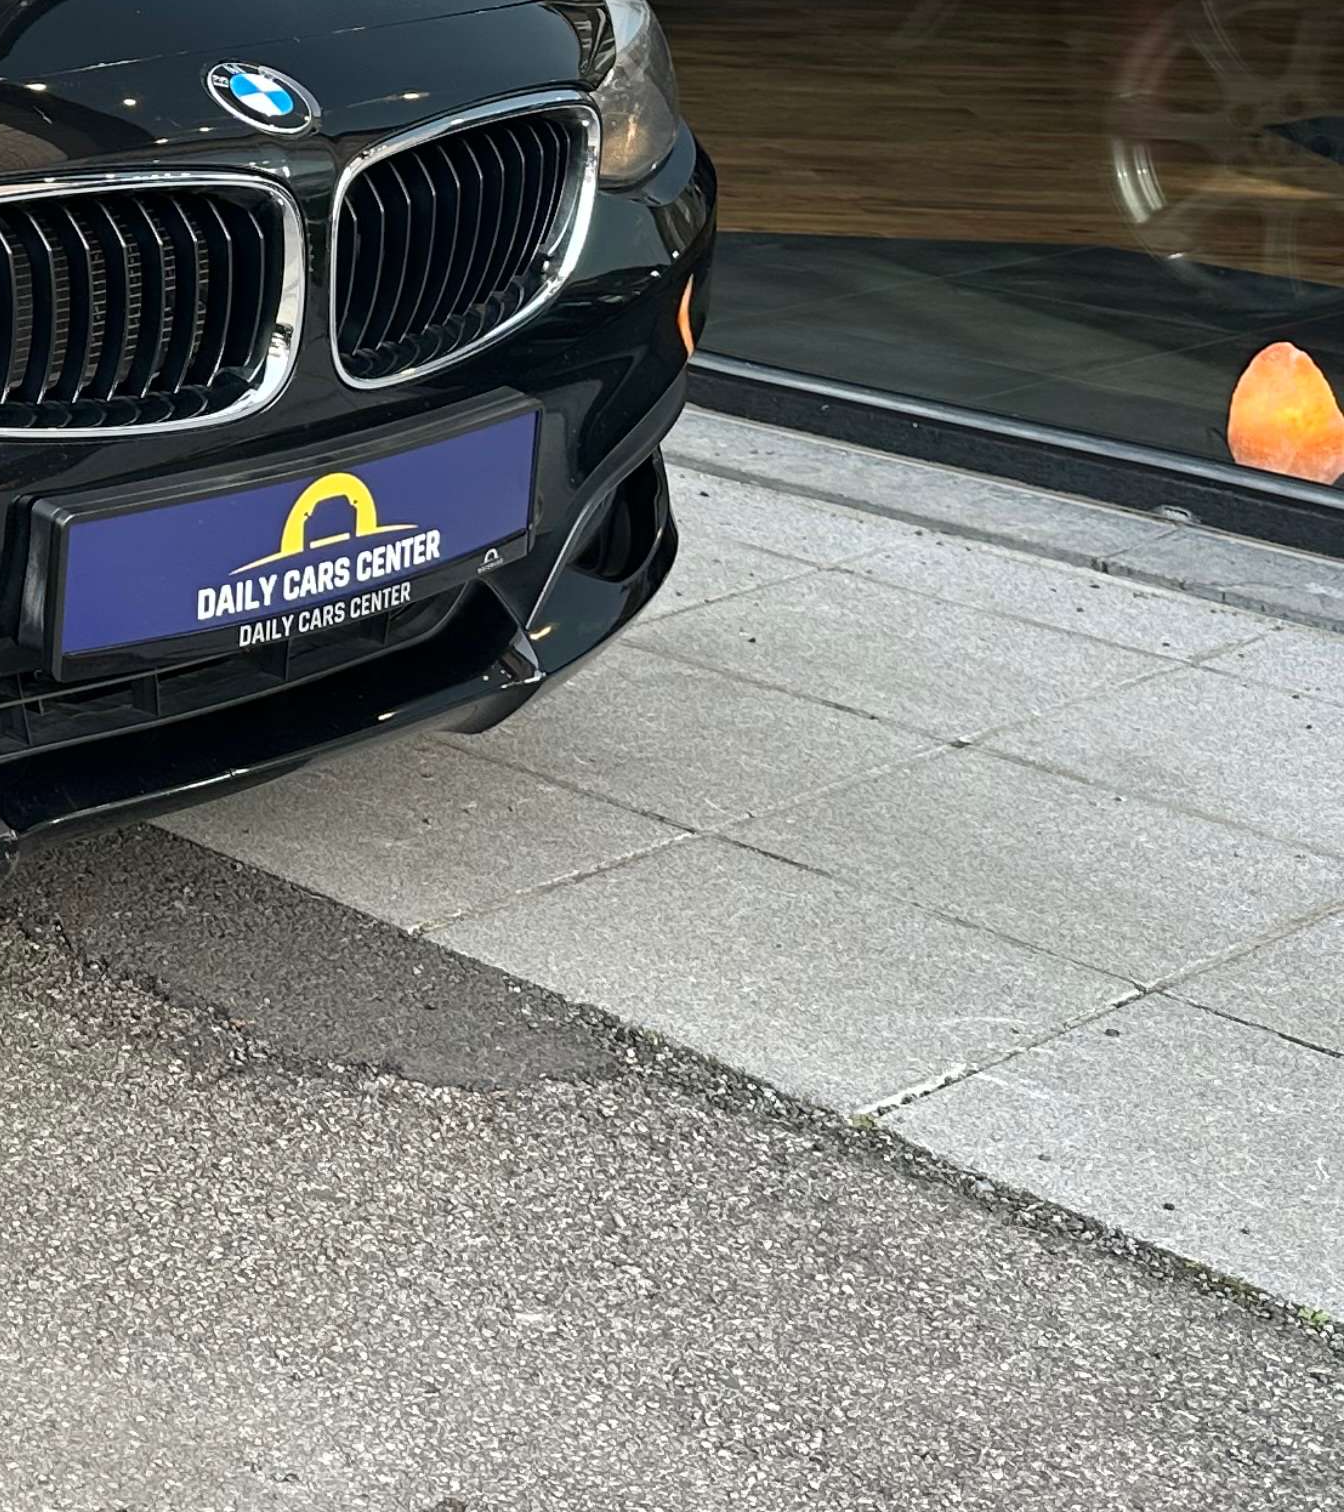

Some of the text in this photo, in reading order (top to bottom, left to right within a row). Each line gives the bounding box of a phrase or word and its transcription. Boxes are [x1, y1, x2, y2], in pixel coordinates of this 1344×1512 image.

[196, 528, 442, 621] DAILY CARS CENTER
[238, 580, 412, 648] DAILY CARS CENTER
